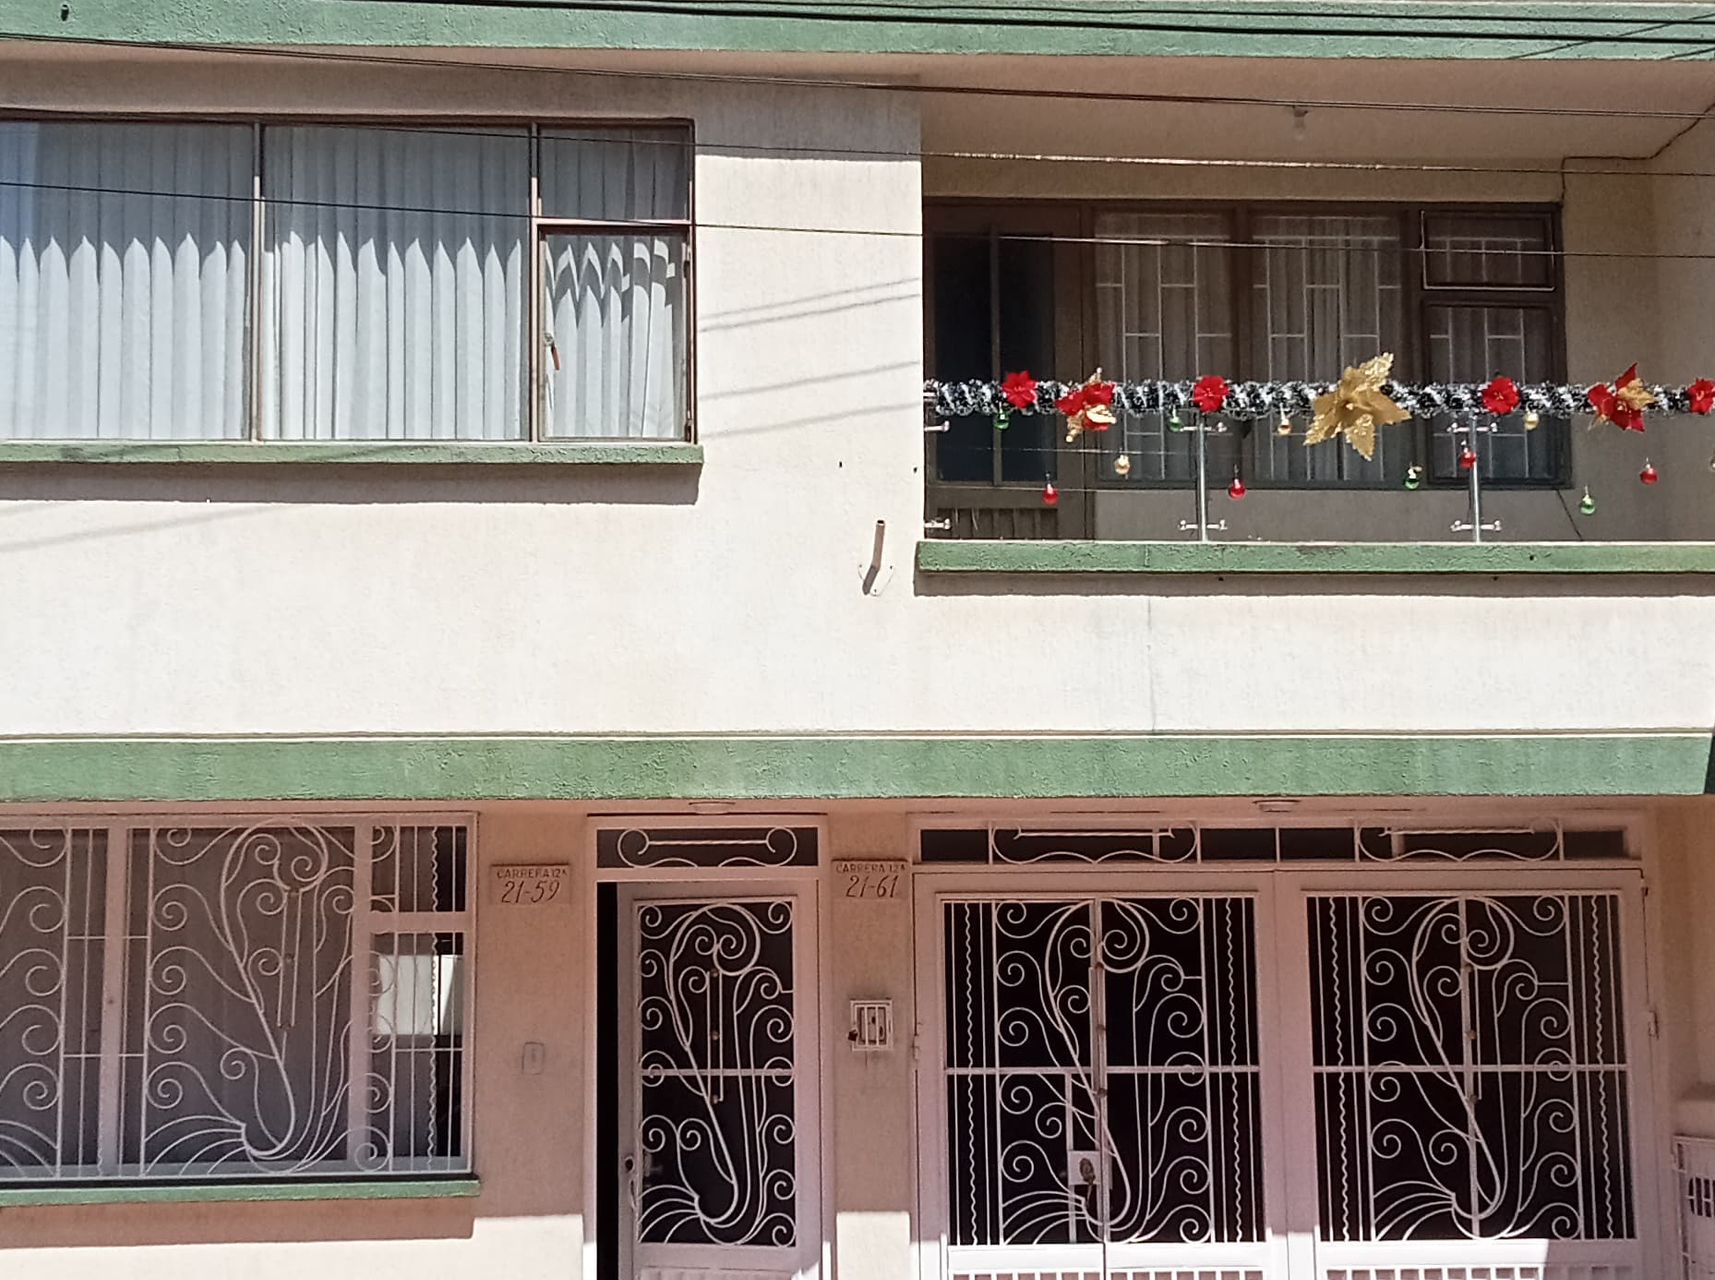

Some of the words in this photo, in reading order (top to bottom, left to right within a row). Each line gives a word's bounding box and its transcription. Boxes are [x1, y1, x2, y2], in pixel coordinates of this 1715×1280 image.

[836, 863, 885, 873] CARRERA
[501, 880, 560, 903] 21-59
[845, 874, 899, 898] 21-61
